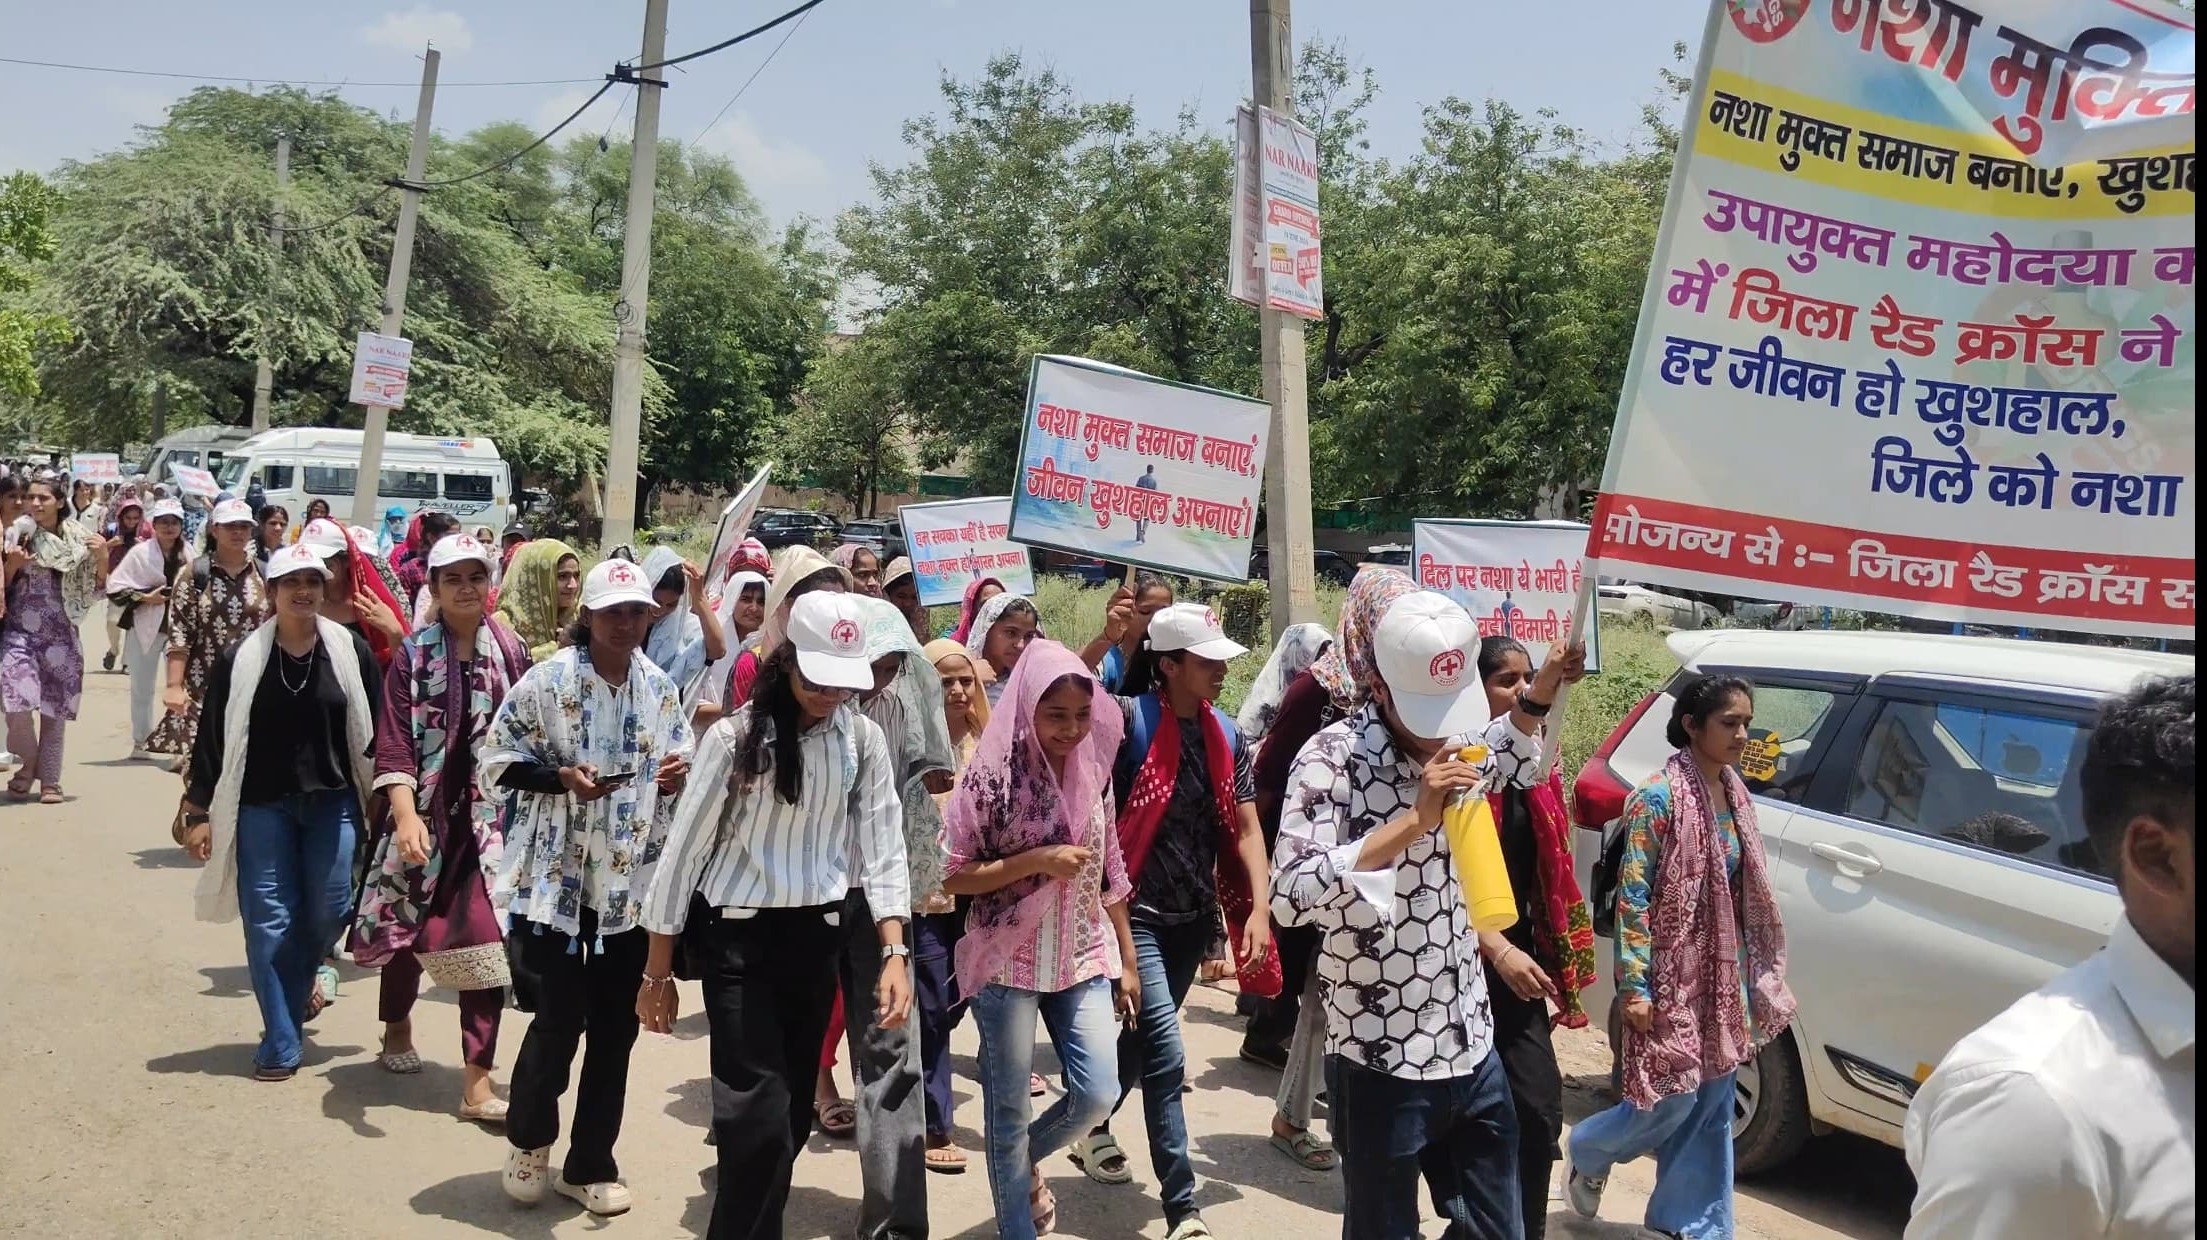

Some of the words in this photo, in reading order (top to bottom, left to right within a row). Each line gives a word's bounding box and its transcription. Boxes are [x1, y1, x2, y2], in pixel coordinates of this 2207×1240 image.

[1831, 0, 1981, 82] नशा
[1709, 90, 1772, 146] नशा
[1776, 110, 1850, 171] मुक्त
[1857, 129, 1958, 185] समाज
[1703, 190, 1895, 274] उपायुक्त
[1907, 232, 2136, 286] महोदया
[1667, 258, 1730, 313] में
[1728, 268, 1859, 342] जिला
[1870, 294, 1943, 357] रैड
[1955, 314, 2104, 367] क्रॉस
[2119, 314, 2183, 368] ने
[1661, 336, 1722, 385] हर
[1728, 336, 1846, 408] जीवन
[1855, 359, 1907, 418] हो
[1915, 378, 2125, 446] खुशहाल,
[1037, 403, 1081, 440] नशा
[1083, 412, 1133, 462] मुक्त
[1135, 423, 1198, 463] समाज
[1201, 434, 1258, 479] बनाएं,
[1871, 436, 1979, 504] जिले
[1989, 452, 2059, 510] को
[2070, 470, 2183, 517] नशा
[1026, 457, 1086, 507] जीवन
[1090, 479, 1172, 529] खुशहाल
[1419, 553, 1452, 590] दिल
[1455, 566, 1476, 590] पर
[1480, 566, 1513, 592] नशा
[1517, 558, 1530, 592] ये
[1535, 559, 1567, 593] भारी
[1744, 525, 1784, 566] से
[1848, 538, 1959, 588] जिला
[1968, 550, 2028, 598] रैड
[2036, 562, 2150, 606] क्रॉस
